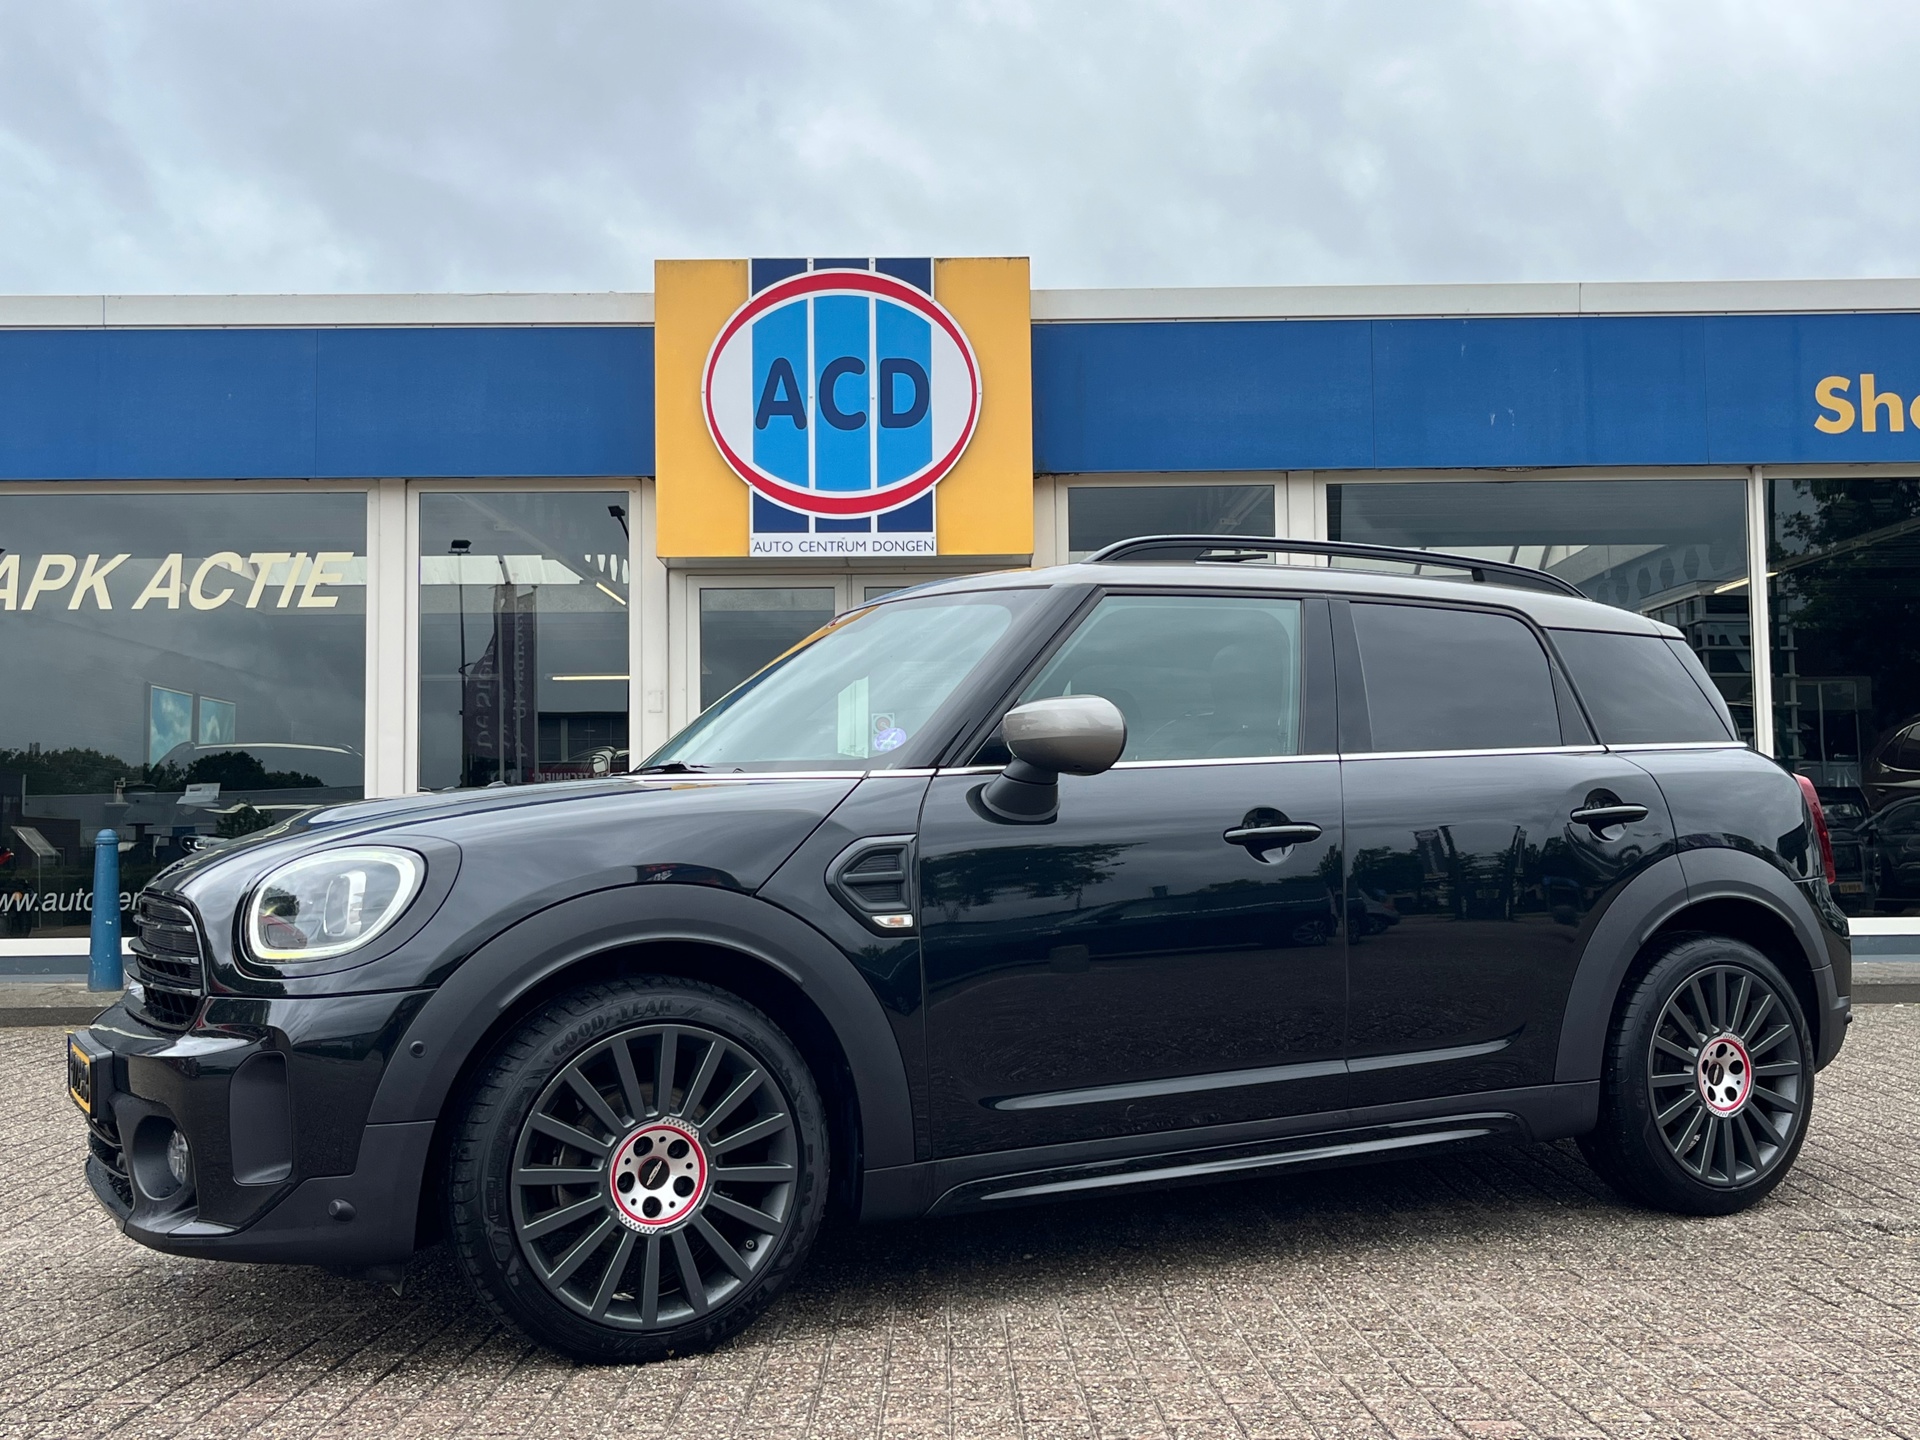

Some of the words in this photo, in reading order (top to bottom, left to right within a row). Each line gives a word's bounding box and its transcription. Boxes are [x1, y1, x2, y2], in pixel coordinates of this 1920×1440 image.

[755, 356, 930, 430] ACD
[1814, 373, 1920, 434] Sh
[753, 541, 793, 552] AUTO
[799, 540, 867, 552] CENTRUM
[872, 540, 934, 552] DONGEN
[0, 554, 132, 611] APK
[131, 551, 354, 610] ACTIE
